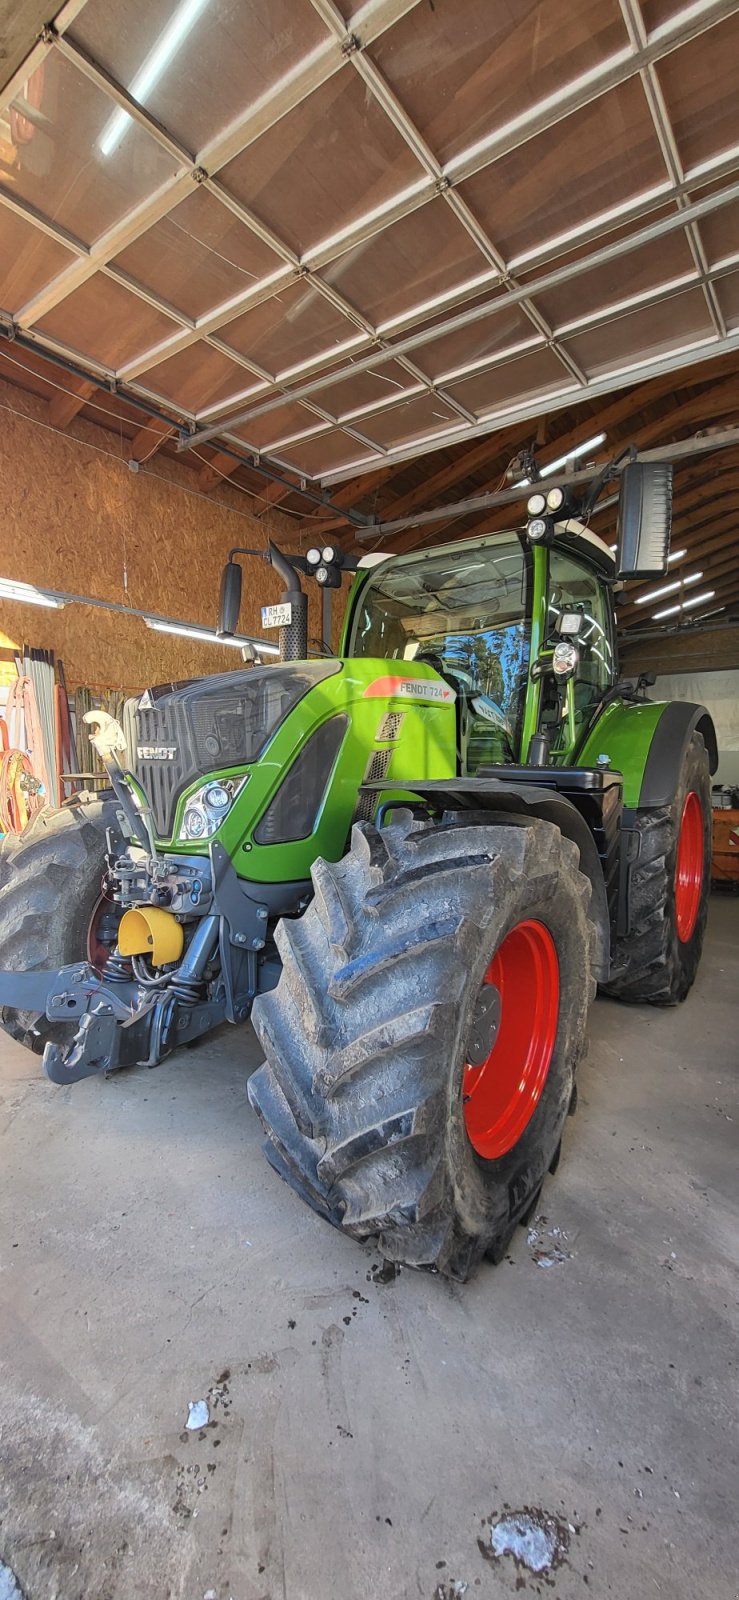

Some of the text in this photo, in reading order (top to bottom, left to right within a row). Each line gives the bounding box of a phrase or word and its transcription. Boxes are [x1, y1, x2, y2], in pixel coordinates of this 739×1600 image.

[268, 606, 278, 616] RH
[400, 682, 443, 697] FENDT 724
[136, 746, 177, 760] FENDT
